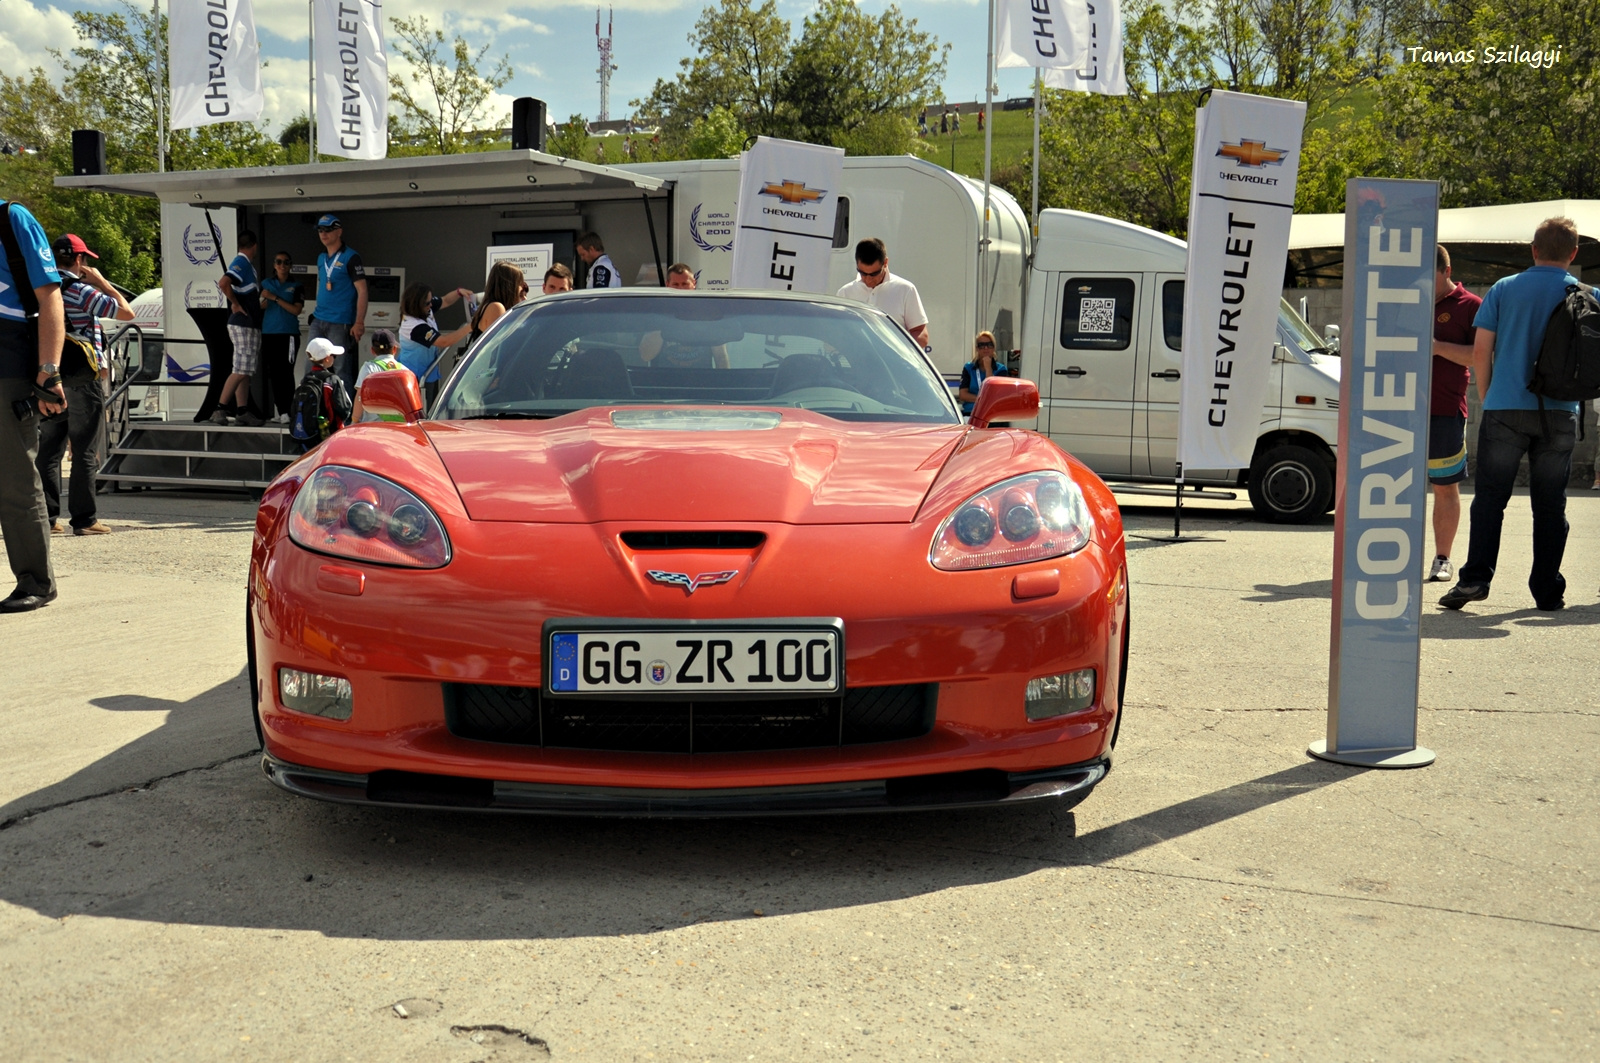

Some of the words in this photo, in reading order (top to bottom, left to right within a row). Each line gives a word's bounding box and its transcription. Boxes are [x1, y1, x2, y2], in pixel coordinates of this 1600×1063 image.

[337, 2, 361, 151] CHEVROLET
[1219, 171, 1278, 186] CHEVROLET
[762, 207, 818, 221] CHEVROLET
[1208, 212, 1256, 427] CHEVROLET
[1355, 226, 1423, 620] CORVETTE
[560, 668, 570, 681] D
[582, 640, 642, 685] GG
[675, 639, 735, 684] ZR
[747, 639, 832, 683] 100
